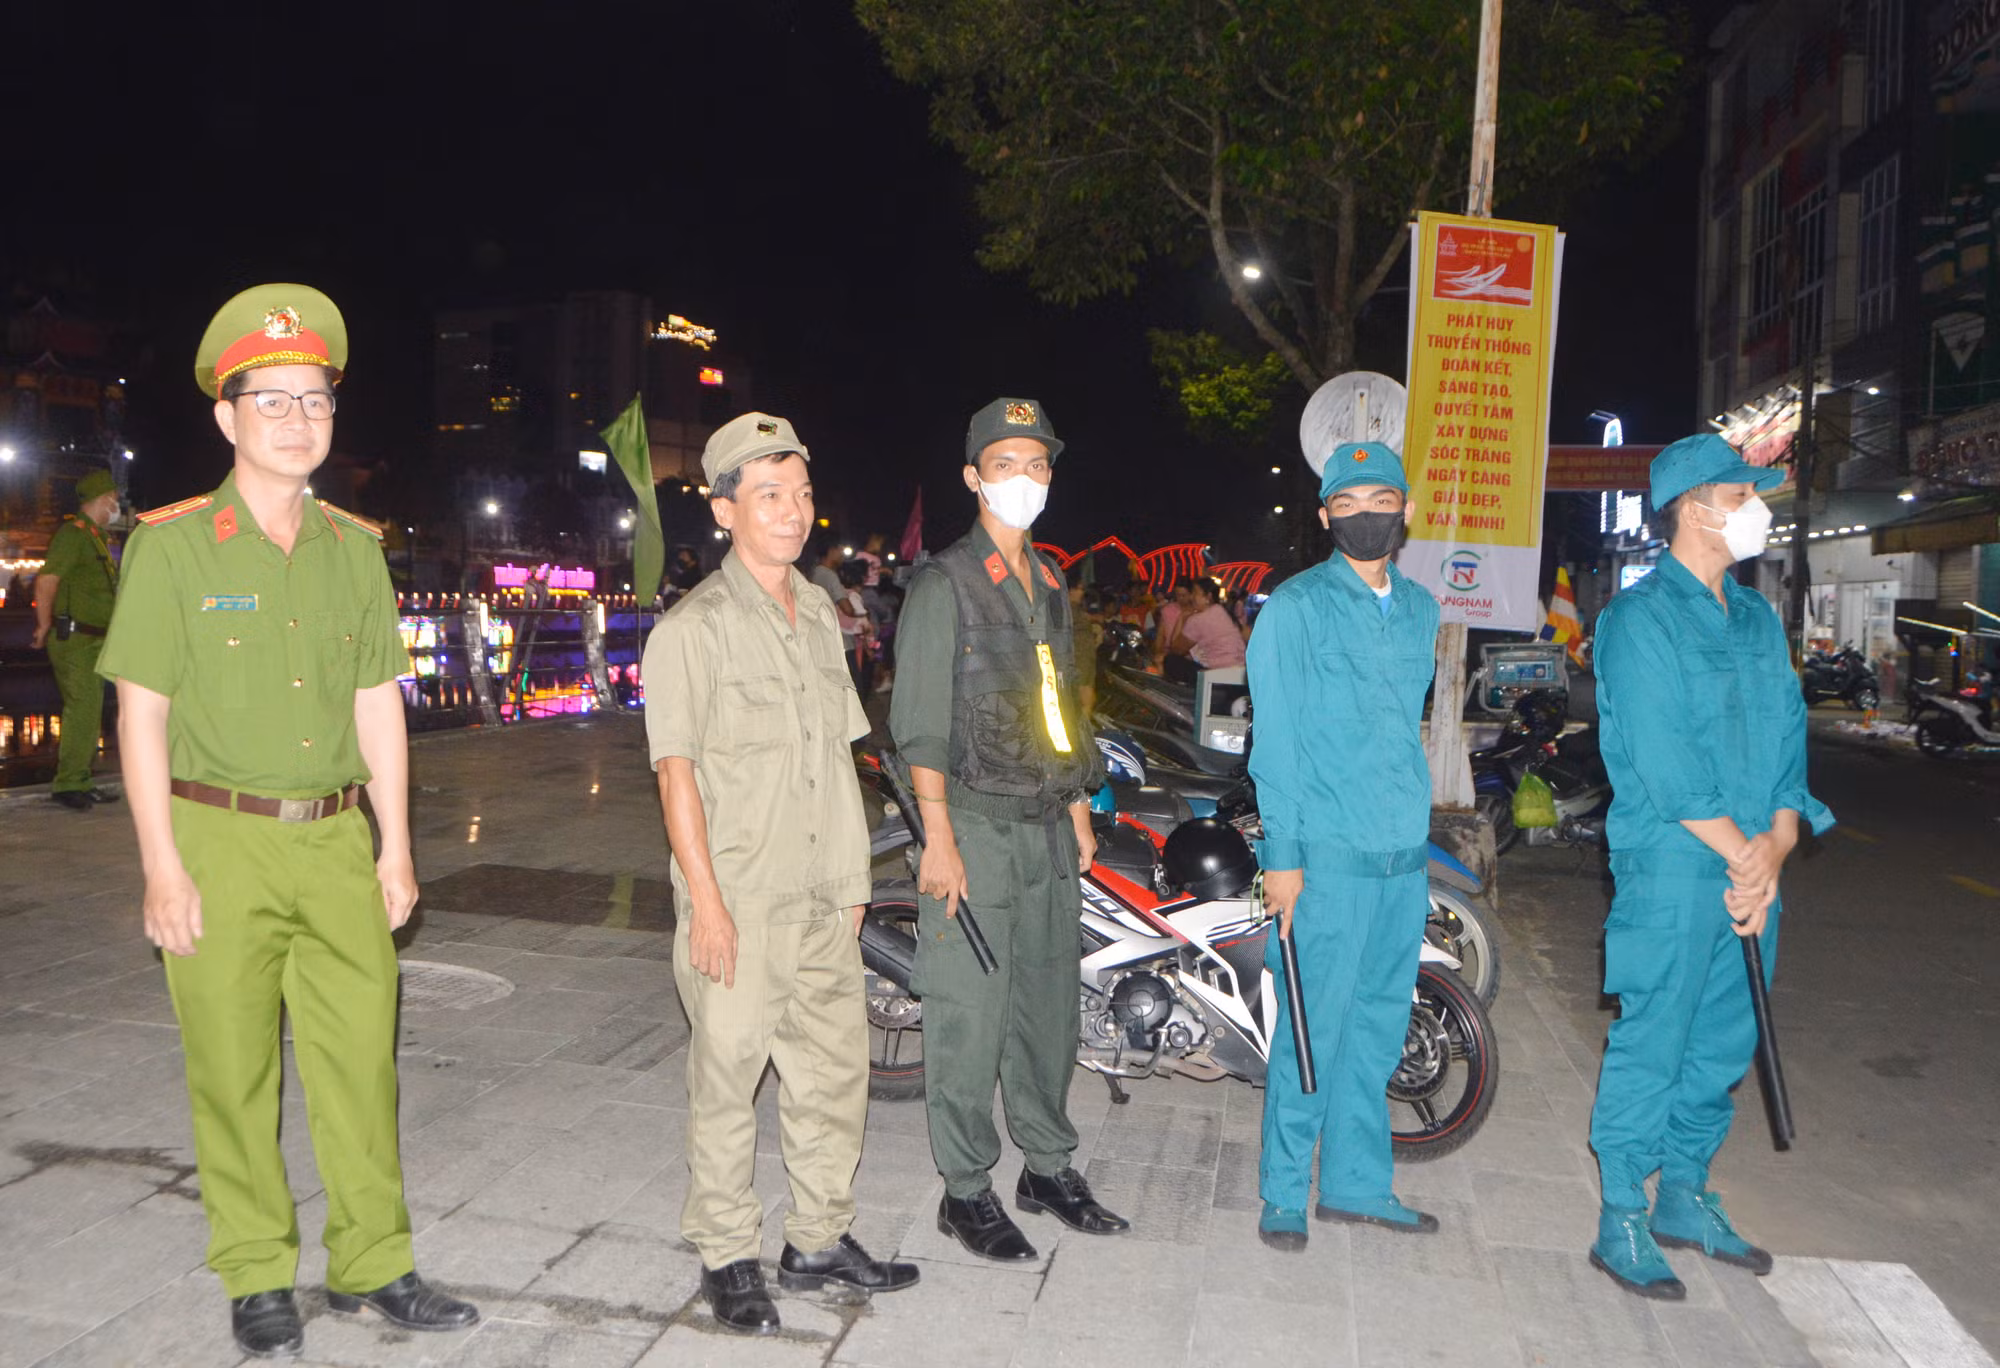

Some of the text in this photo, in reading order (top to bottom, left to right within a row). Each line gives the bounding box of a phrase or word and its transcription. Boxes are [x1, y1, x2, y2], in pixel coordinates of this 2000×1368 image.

[1486, 316, 1514, 331] HUY
[1430, 444, 1460, 460] SÓC
[1461, 513, 1505, 530] MINH!
[1465, 608, 1492, 618] Group
